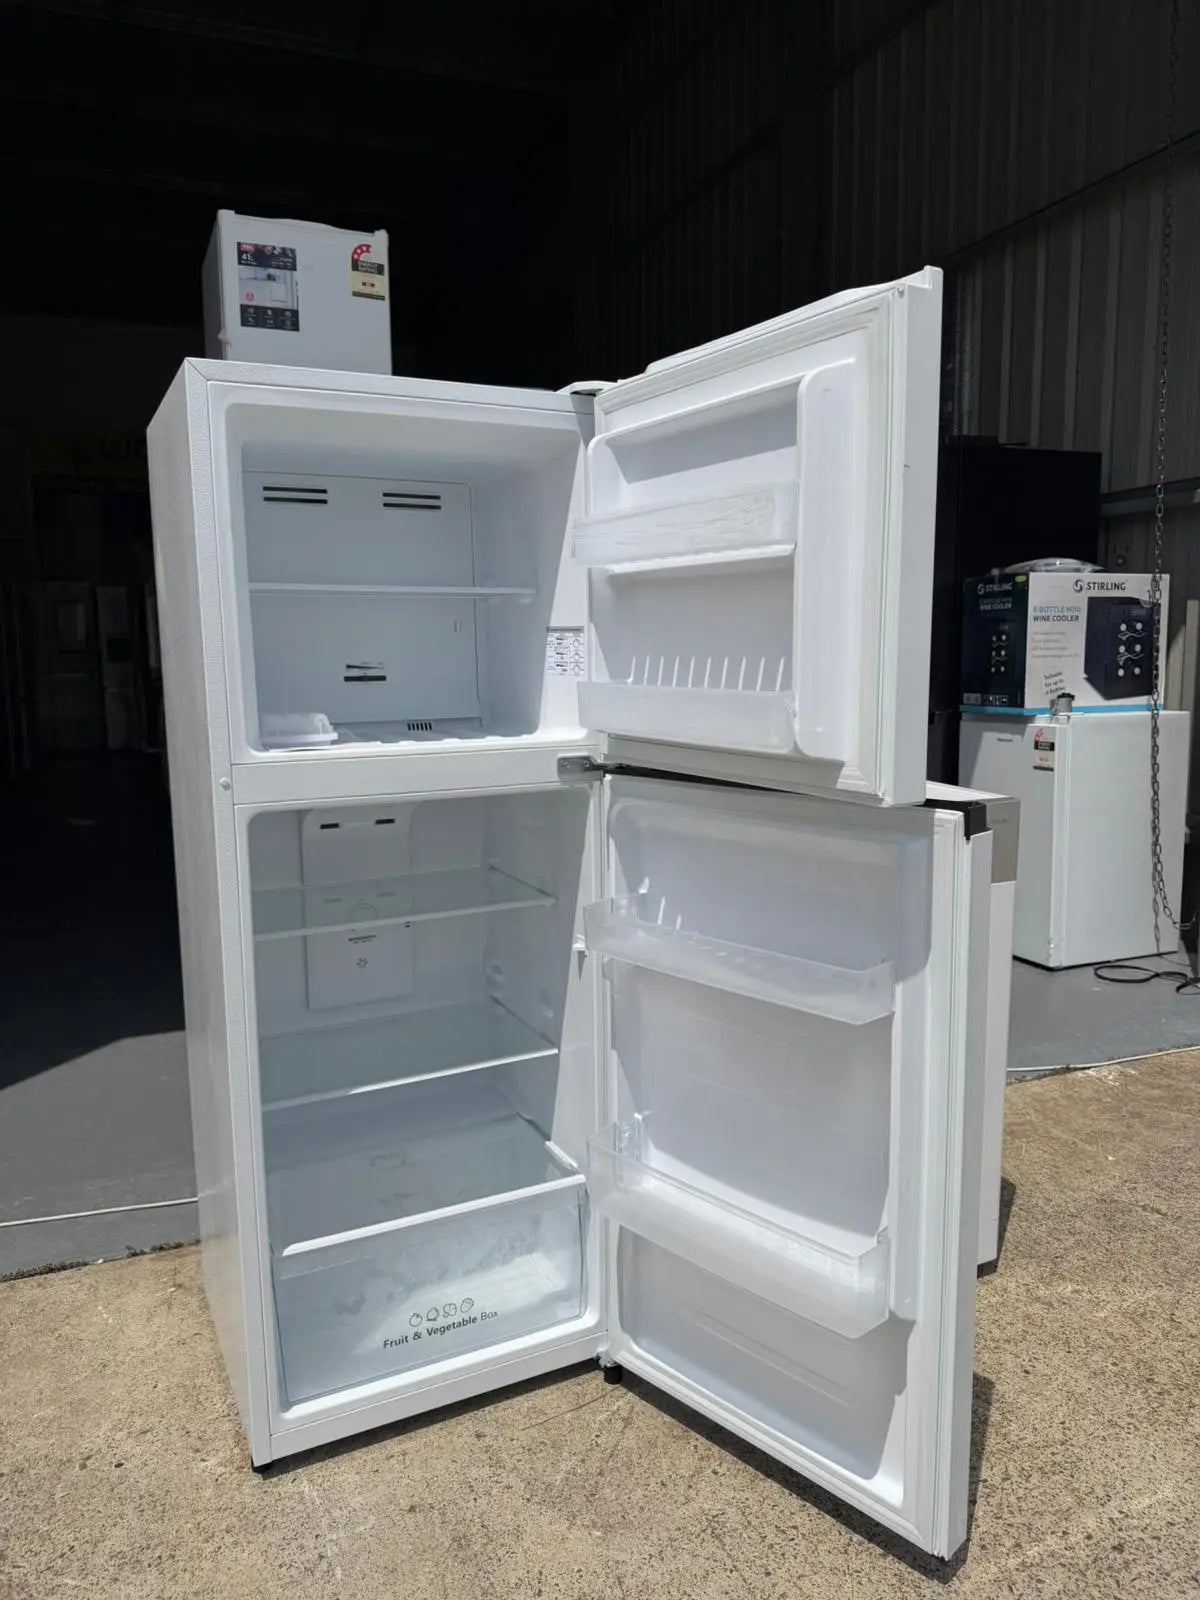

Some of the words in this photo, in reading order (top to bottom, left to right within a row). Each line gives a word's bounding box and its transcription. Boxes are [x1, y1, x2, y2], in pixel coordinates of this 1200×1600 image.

[985, 582, 1013, 592] STIRLING
[1086, 581, 1127, 591] STIRLING
[1033, 614, 1051, 622] WINE
[1051, 614, 1079, 622] COOLER
[383, 1335, 409, 1349] Fruit
[412, 1331, 423, 1341] &
[426, 1316, 478, 1336] Vegetable
[480, 1310, 499, 1321] Box
